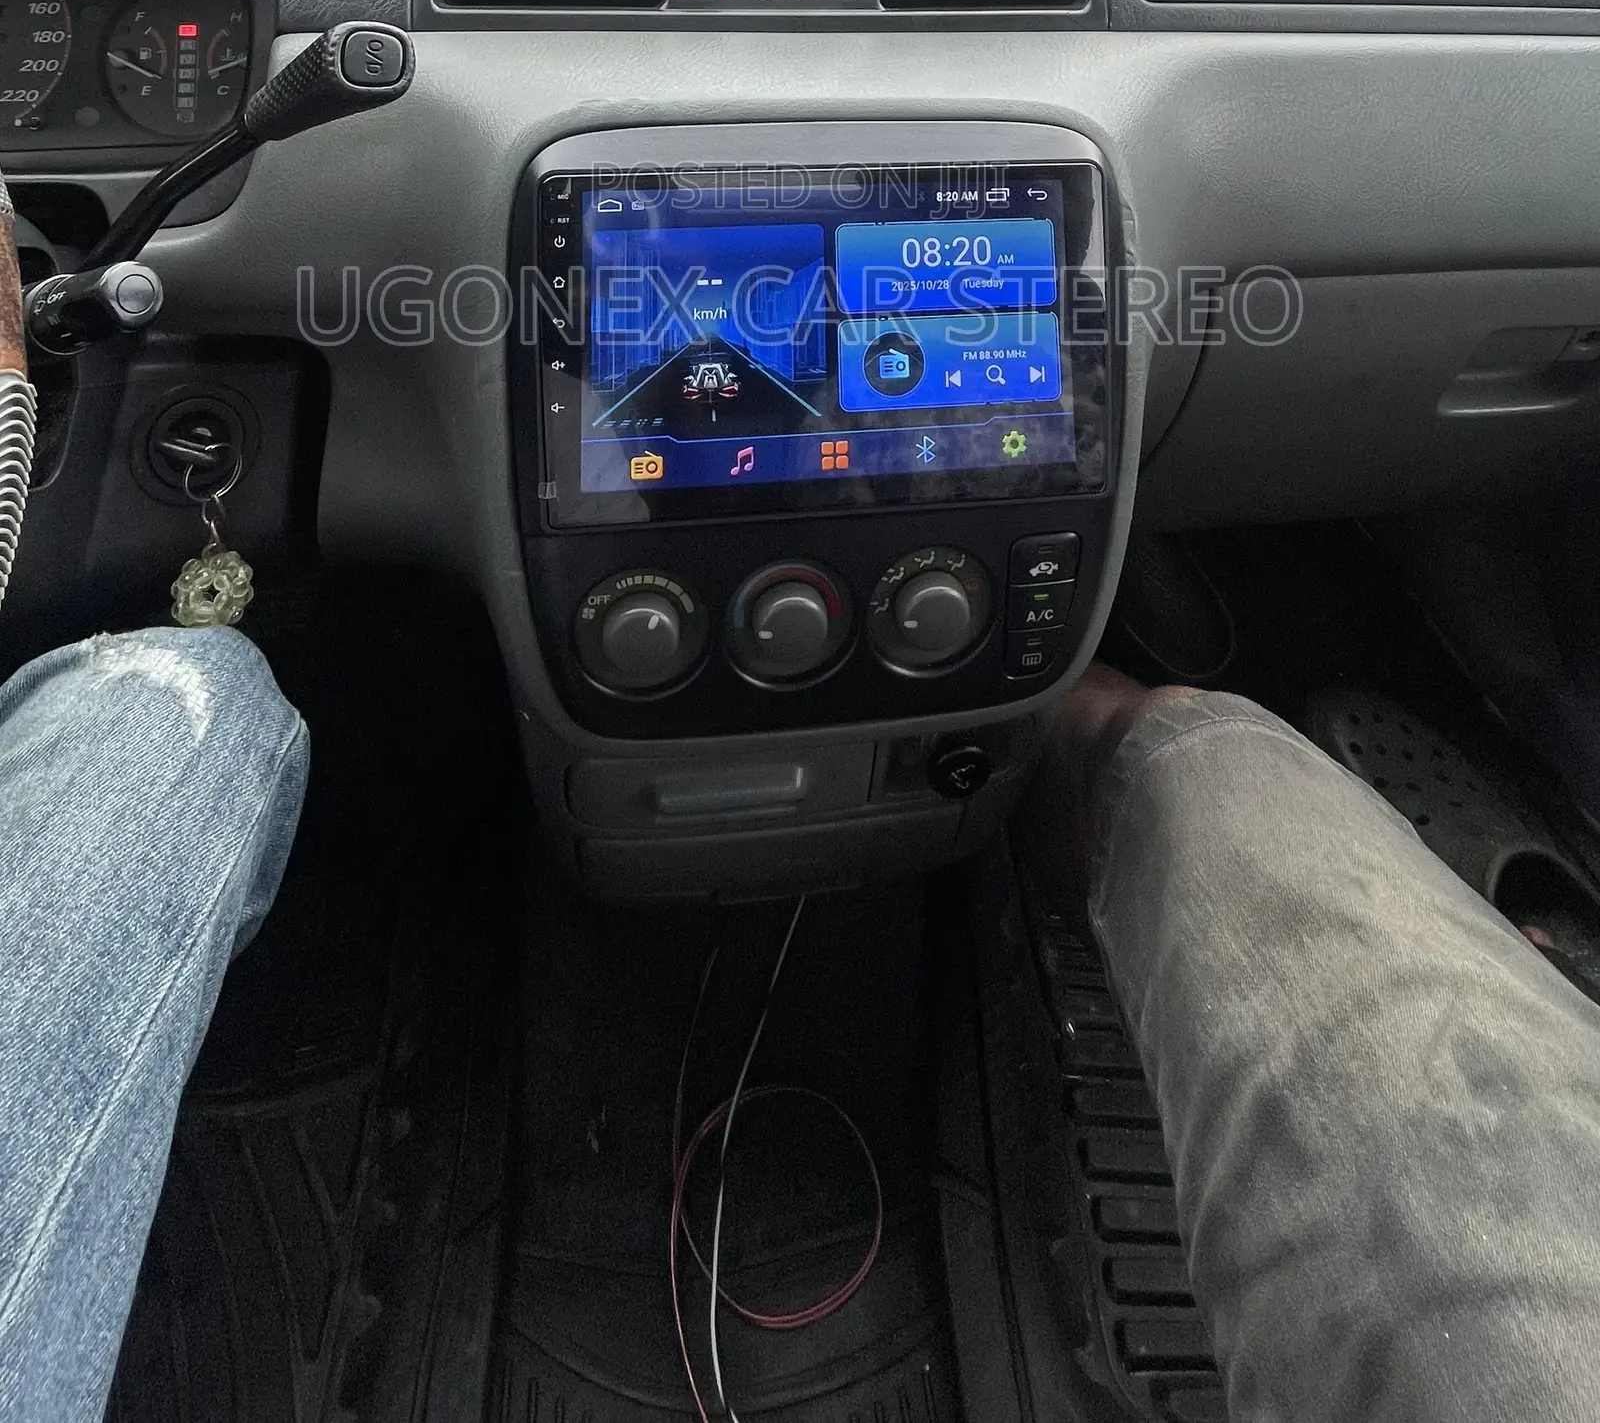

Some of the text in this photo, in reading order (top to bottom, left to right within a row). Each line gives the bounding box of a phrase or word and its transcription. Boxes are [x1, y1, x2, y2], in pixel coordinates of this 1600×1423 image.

[28, 2, 61, 14] 160
[134, 11, 146, 21] F
[229, 12, 242, 22] H
[32, 30, 65, 43] 180
[366, 39, 384, 76] O/D
[19, 59, 59, 72] 200
[0, 89, 39, 102] 220
[140, 85, 152, 96] E
[216, 85, 230, 95] C
[936, 191, 978, 202] 8:20 AM
[902, 236, 1014, 268] 08:20 AM
[891, 278, 1004, 292] 2025/10/28 Tuesday
[693, 307, 727, 320] km/h
[963, 349, 1027, 361] FM 88.90 MHz
[587, 594, 611, 606] OFF
[1026, 609, 1054, 622] A/C
